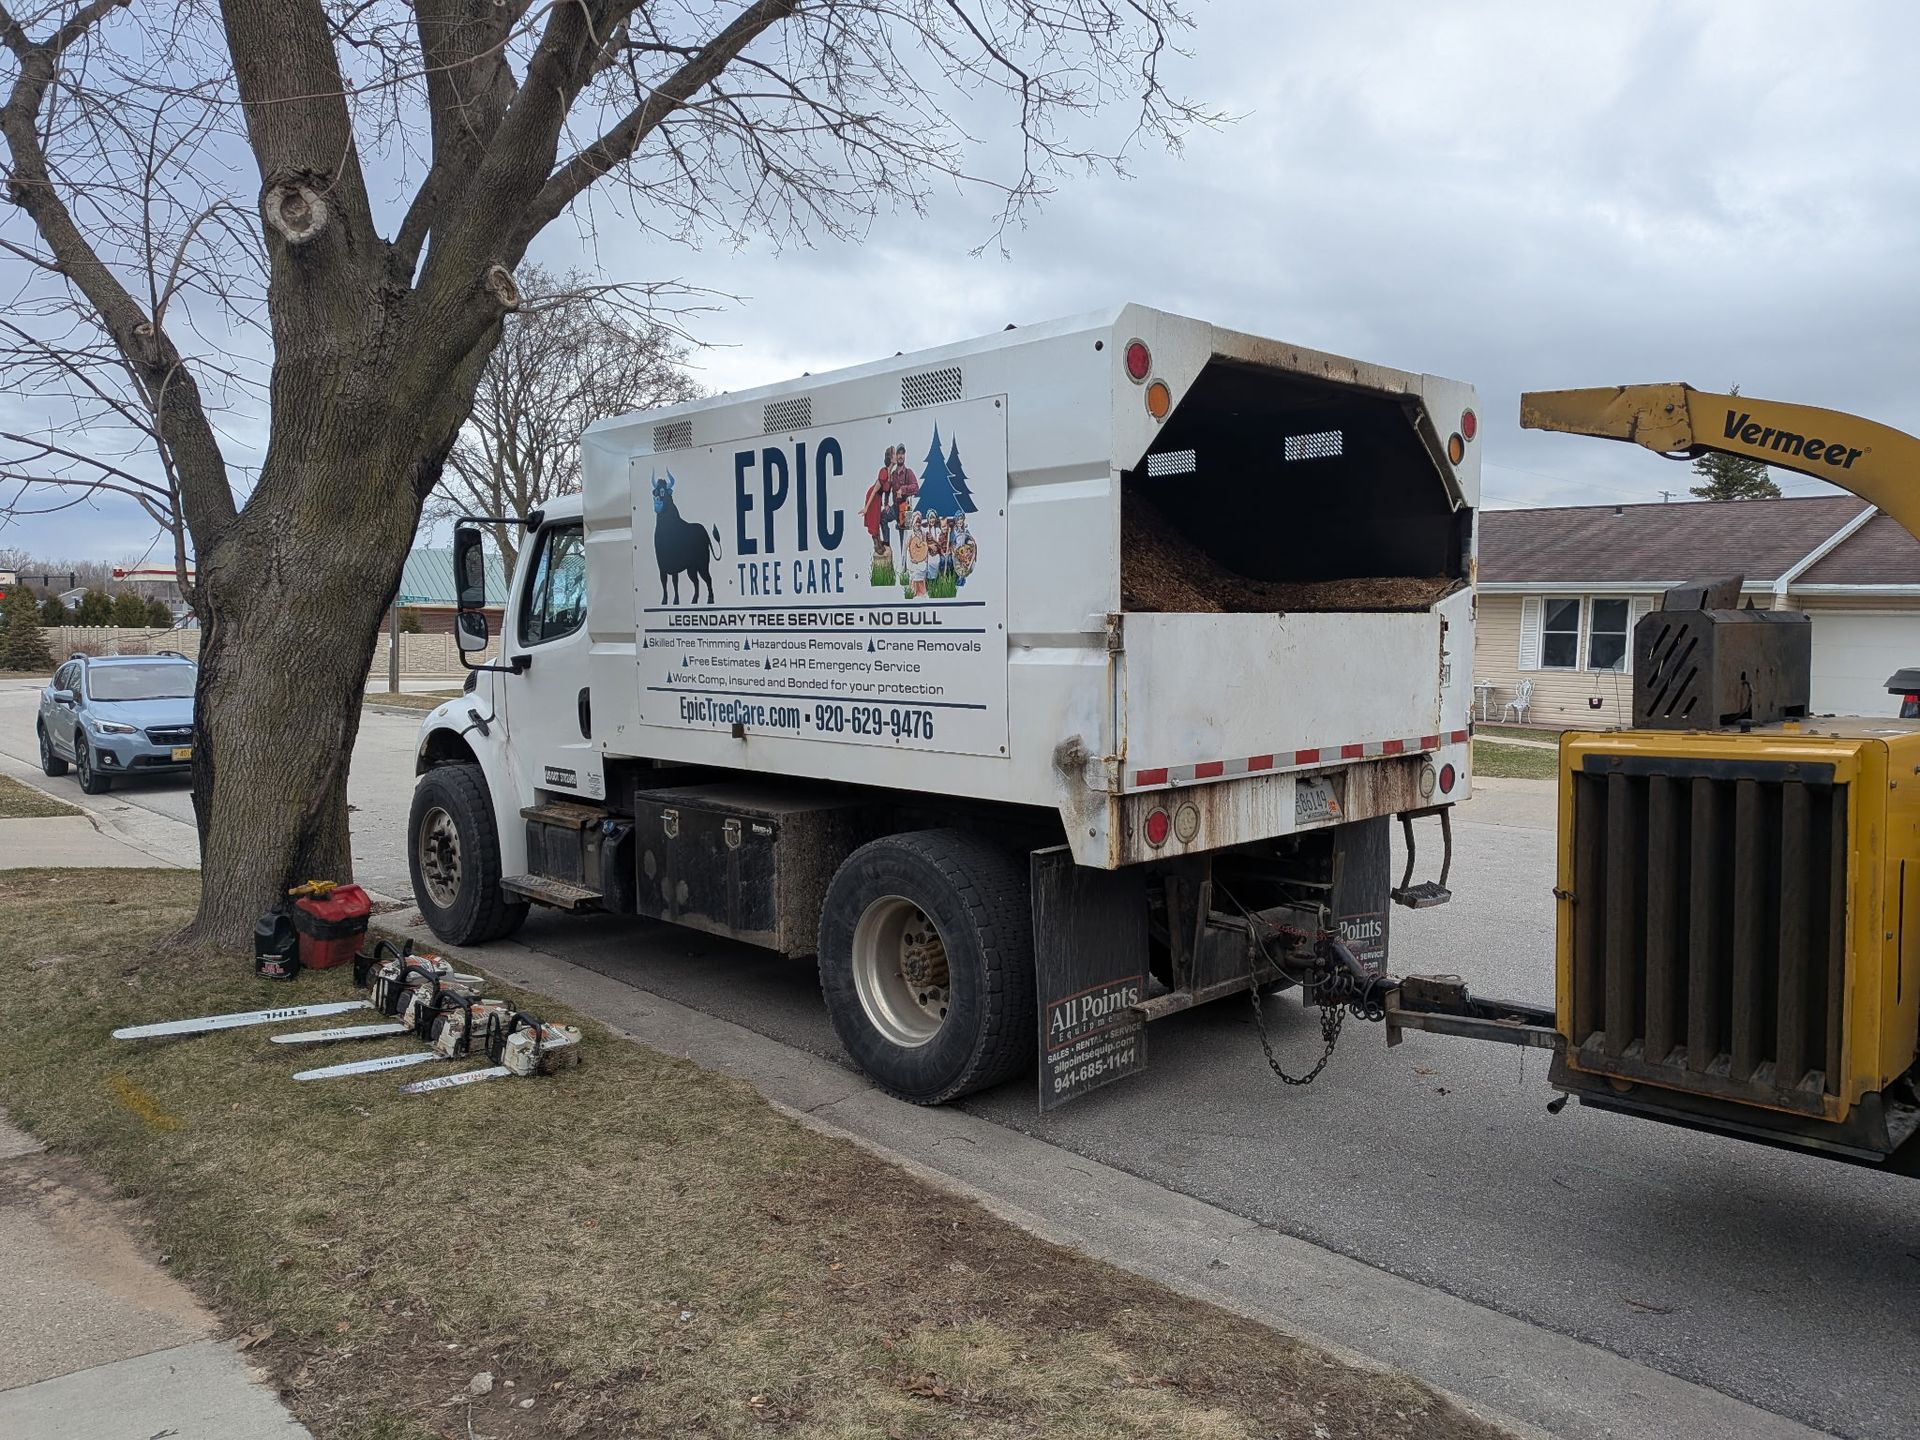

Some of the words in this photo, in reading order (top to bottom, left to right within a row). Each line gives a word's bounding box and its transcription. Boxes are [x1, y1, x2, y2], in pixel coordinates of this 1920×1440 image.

[1723, 409, 1863, 469] Vermeer
[734, 436, 845, 556] EPIC
[738, 560, 782, 596] TREE
[793, 557, 845, 595] CARE
[668, 613, 747, 627] LEGENDARY
[749, 613, 785, 626] TREE
[788, 612, 855, 626] SERVICE
[868, 612, 893, 625] NO
[897, 611, 942, 625] BULL
[649, 637, 675, 648] Skilled
[676, 638, 696, 648] Tree
[697, 638, 740, 651] Trimming
[751, 639, 806, 650] Hazardous
[809, 639, 863, 650] Removals
[877, 639, 914, 651] Crane
[917, 639, 982, 652] Removals
[688, 656, 710, 666] Free
[711, 656, 761, 668] Estimates
[772, 658, 787, 669] 24
[789, 659, 807, 669] HR
[809, 659, 871, 673] Emergency
[874, 660, 921, 673] Service
[673, 673, 697, 684] Work
[698, 674, 727, 687] Comp,
[728, 675, 765, 687] Insured
[767, 676, 785, 687] and
[788, 677, 829, 690] Bonded
[831, 679, 847, 691] for
[849, 682, 876, 694] your
[877, 683, 944, 695] protection
[679, 696, 800, 729] EpicTreeCare.com
[815, 704, 934, 740] 920-629-9476
[1339, 918, 1382, 940] Points
[1360, 950, 1385, 961] SERVICE
[260, 1008, 308, 1020] STIHL
[1050, 999, 1078, 1035] All
[1081, 987, 1138, 1022] Points
[1047, 1047, 1070, 1064] SALES
[1075, 1036, 1104, 1052] RENTAL
[1110, 1021, 1141, 1039] SERVICE
[376, 1058, 406, 1067] STIHL
[1054, 1036, 1135, 1074] allpointsequip.com
[457, 1072, 487, 1082] STIHL
[1054, 1048, 1135, 1094] 941-685-1141
